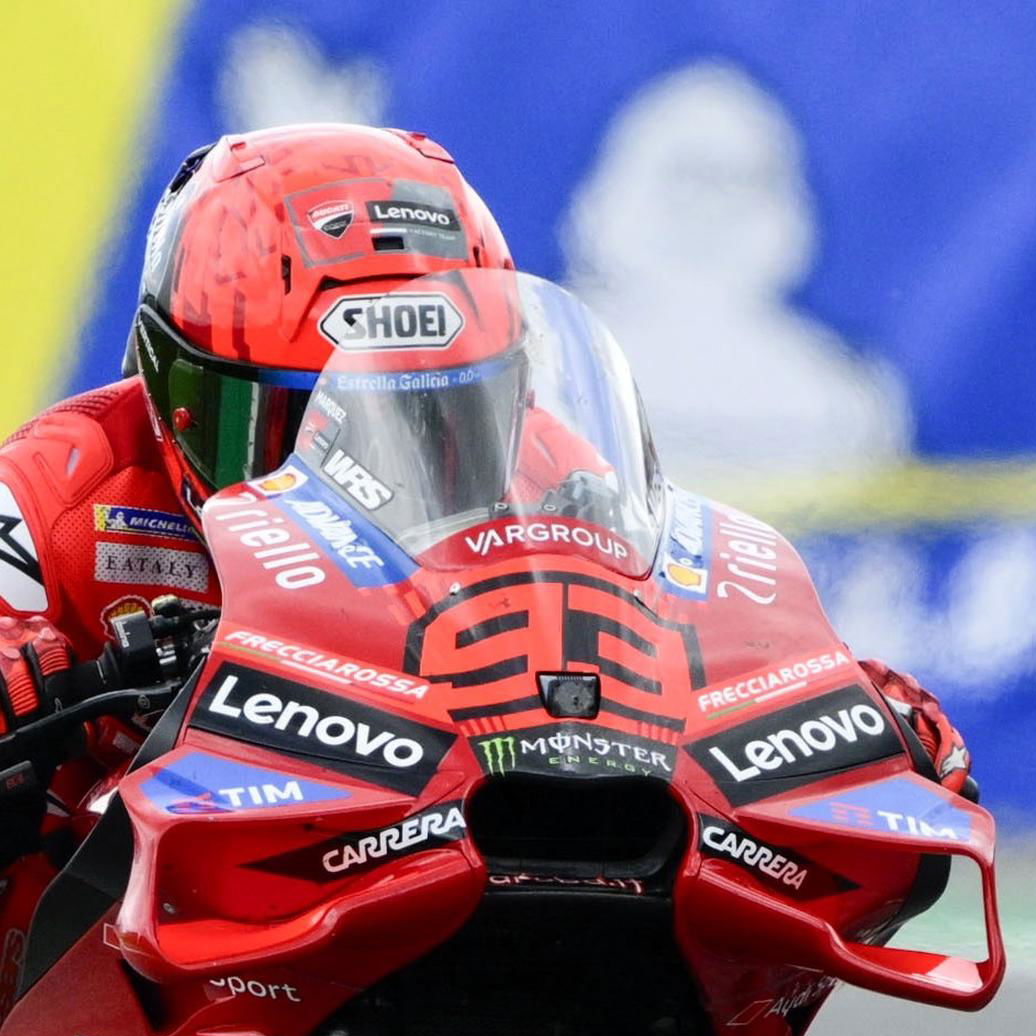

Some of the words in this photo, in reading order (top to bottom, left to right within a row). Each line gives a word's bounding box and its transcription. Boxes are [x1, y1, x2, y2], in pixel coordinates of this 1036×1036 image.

[374, 204, 450, 225] Lenovo
[342, 304, 446, 339] SHOEI
[337, 374, 395, 390] Estrella
[399, 372, 448, 389] Galicia
[323, 448, 394, 511] WRS
[106, 555, 198, 579] EATALY
[224, 629, 431, 700] FRECCIAROSSA
[698, 650, 851, 713] FRECCIAROSSA
[207, 674, 425, 768] Lenovo
[519, 732, 673, 773] MONSTER
[708, 703, 887, 783] Lenovo
[548, 754, 653, 777] ENERGY
[218, 780, 305, 808] TIM
[321, 806, 468, 874] CARRERA
[877, 810, 959, 841] TIM
[701, 825, 809, 891] CARRERA
